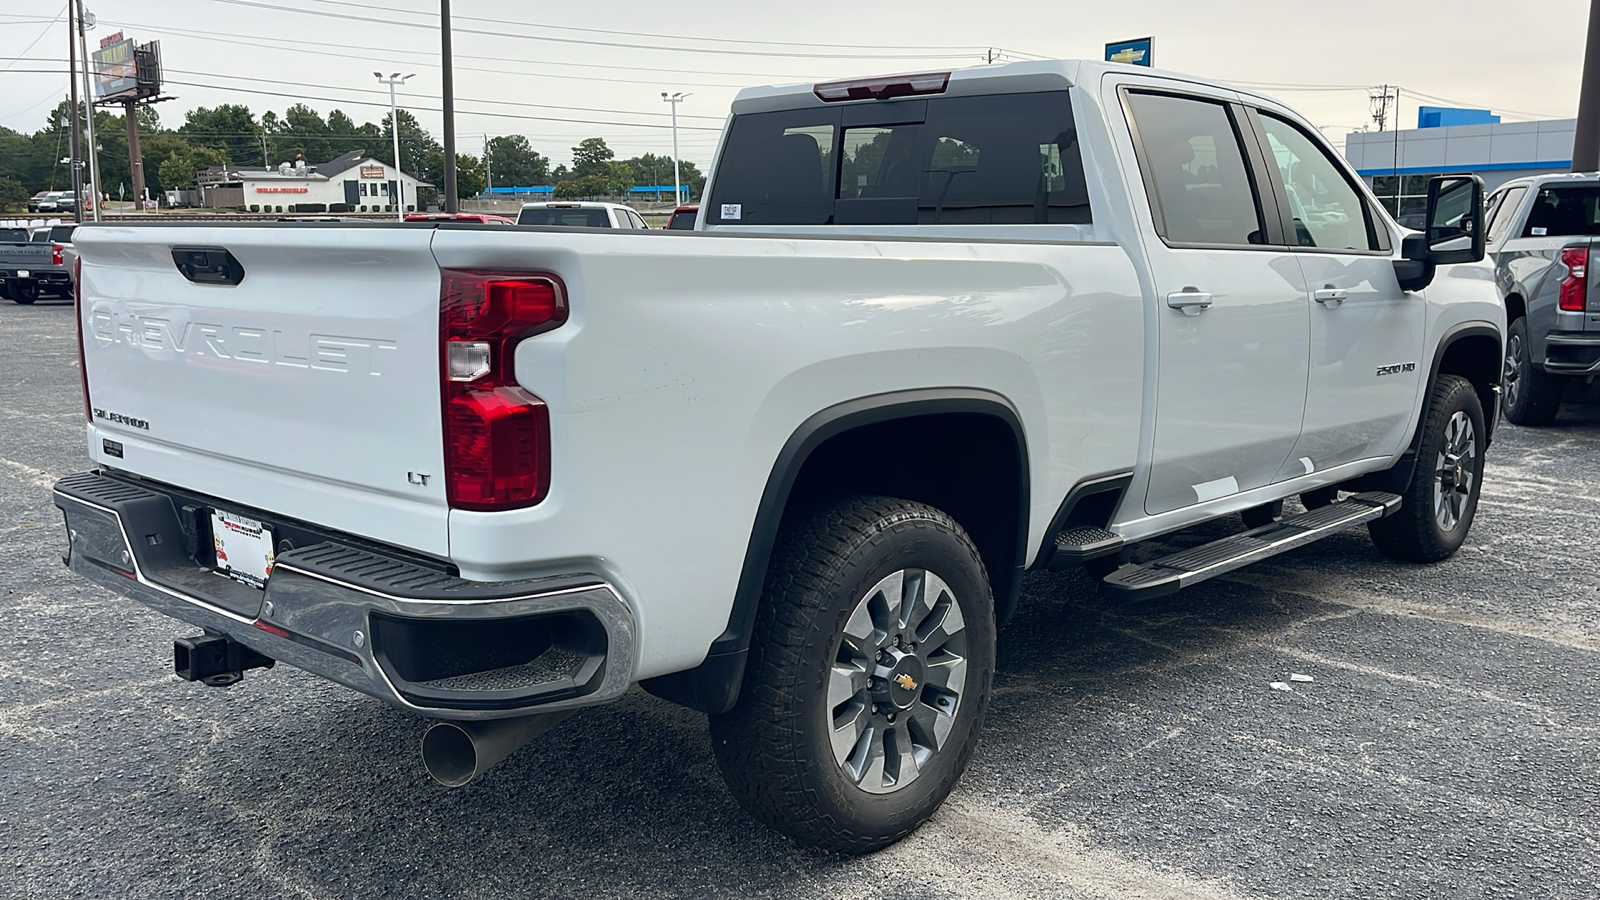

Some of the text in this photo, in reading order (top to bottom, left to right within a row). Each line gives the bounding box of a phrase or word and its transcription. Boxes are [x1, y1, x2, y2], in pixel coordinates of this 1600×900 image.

[92, 309, 397, 376] CHEVROLET
[1376, 362, 1415, 376] 2500 HD
[93, 407, 150, 430] SILVERADO
[407, 471, 431, 486] LT
